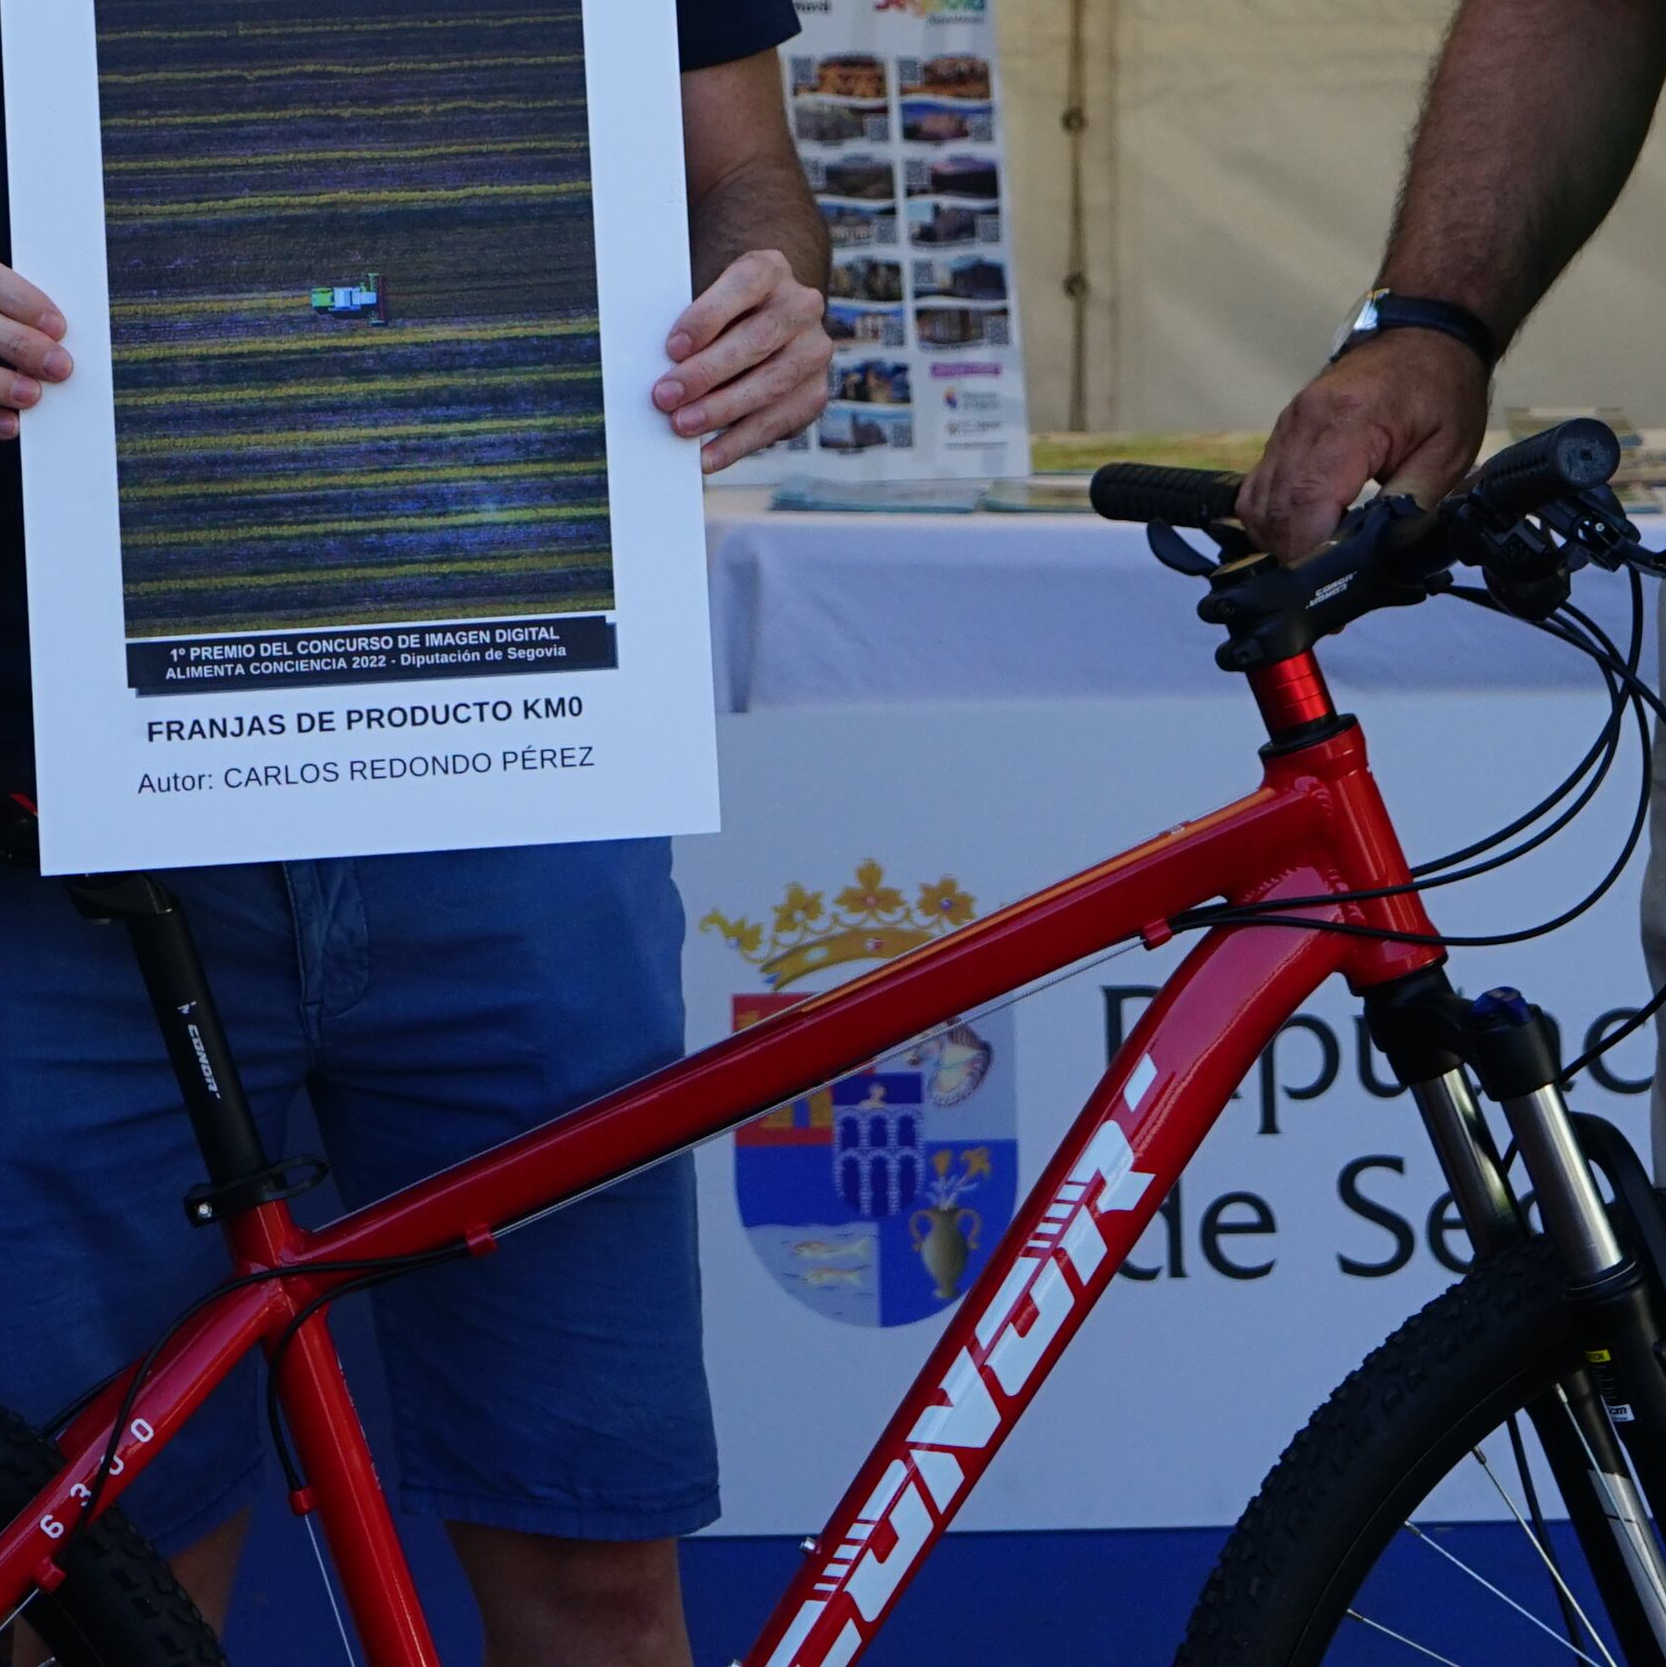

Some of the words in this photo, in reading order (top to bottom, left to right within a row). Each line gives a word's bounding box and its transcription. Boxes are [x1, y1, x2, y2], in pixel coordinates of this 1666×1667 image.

[166, 663, 245, 680] ALIMENTA
[250, 658, 347, 676] CONCIENCIA
[352, 655, 386, 670] 2022
[400, 649, 481, 668] Diputación
[485, 648, 502, 661] de
[508, 645, 567, 661] Segovia
[190, 644, 255, 661] PREMIO
[260, 642, 293, 657] DEL
[297, 635, 393, 655] CONCURSO
[398, 634, 420, 649] DE
[426, 630, 490, 647] IMAGEN
[495, 626, 560, 644] DIGITAL
[147, 714, 286, 743] FRANJAS
[297, 711, 336, 734] DE
[347, 700, 513, 731] PRODUCTO
[523, 696, 583, 720] KM0
[138, 773, 213, 794] Autor:
[224, 762, 339, 788] CARLOS
[350, 752, 492, 781] REDONDO
[502, 745, 595, 771] PÉREZ
